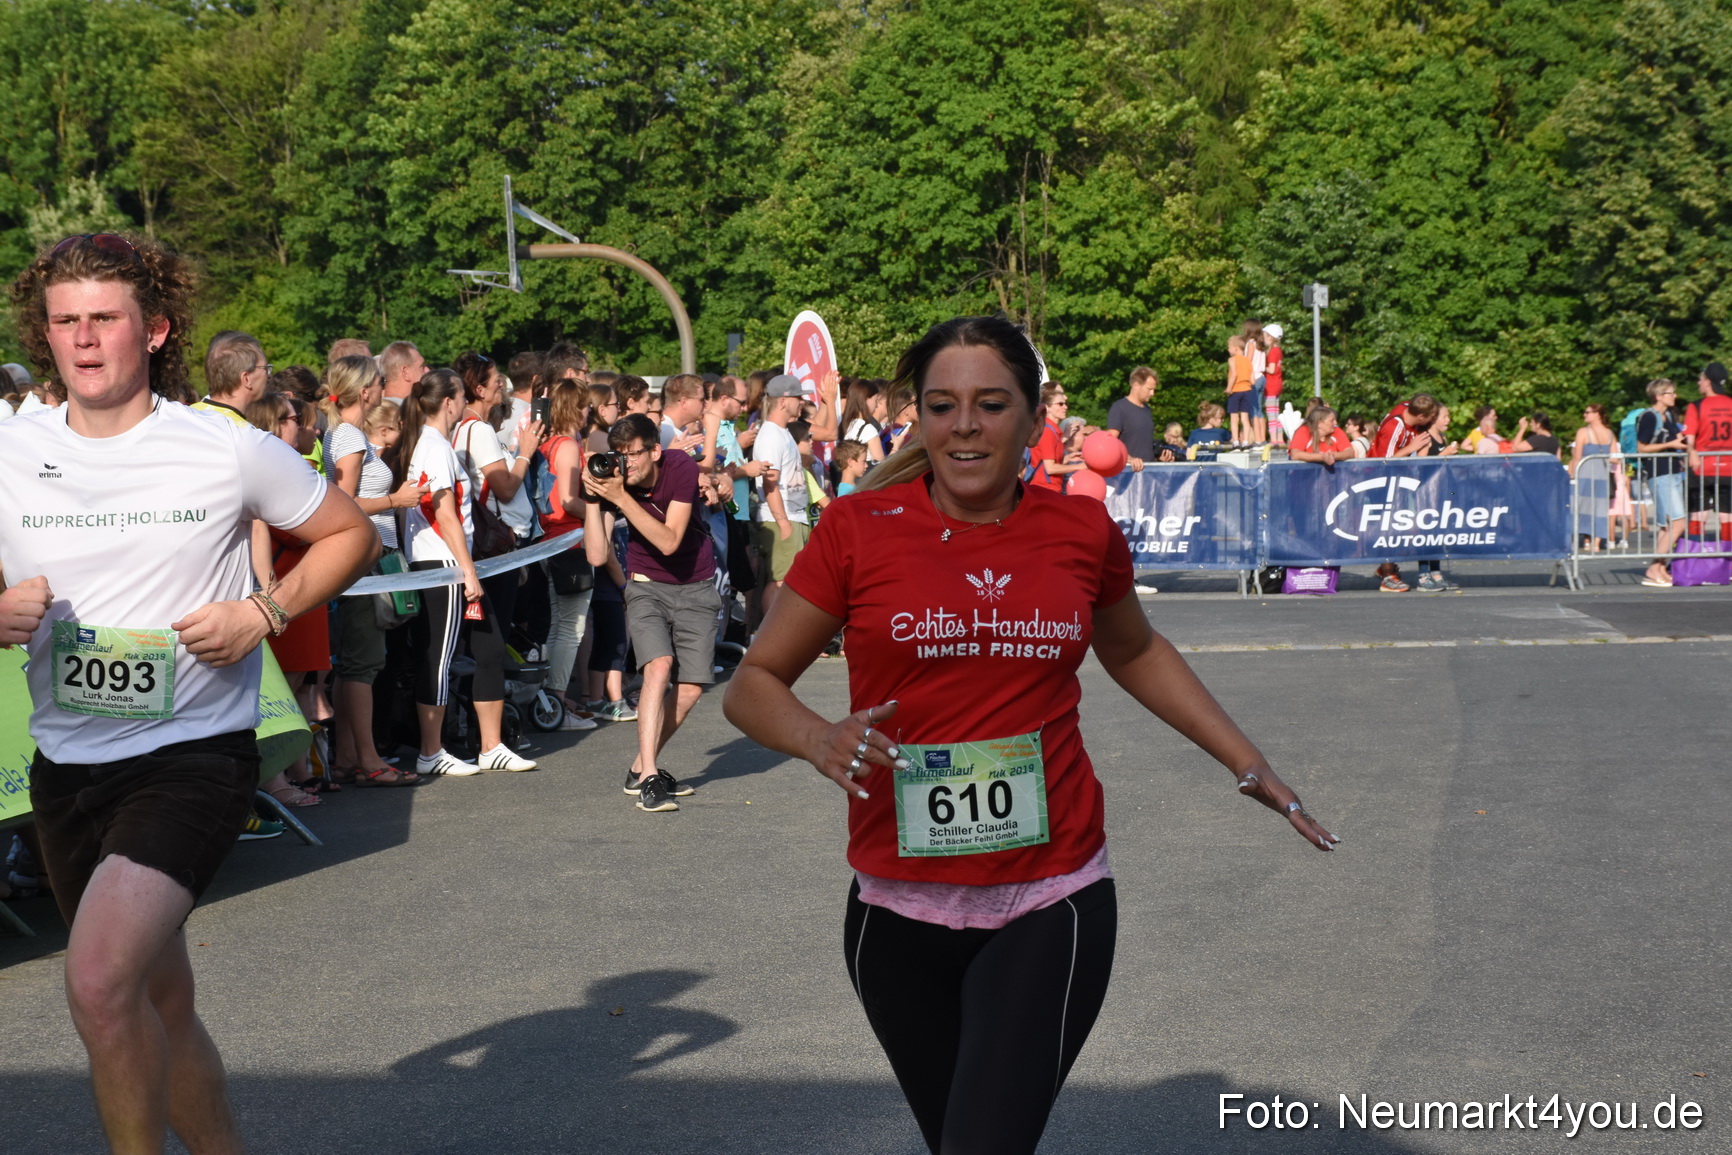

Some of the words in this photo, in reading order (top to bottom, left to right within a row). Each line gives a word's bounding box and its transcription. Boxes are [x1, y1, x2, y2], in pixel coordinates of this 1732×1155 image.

[22, 513, 117, 528] RUPPRECHT
[127, 509, 207, 525] HOLZBAU
[882, 506, 904, 516] JAKO
[1359, 500, 1509, 532] Fischer
[1114, 508, 1202, 537] cher
[1373, 532, 1496, 548] AUTOMOBILE
[890, 607, 969, 641] Echtes
[972, 608, 1083, 641] Handwerk
[917, 643, 980, 659] IMMER
[990, 643, 1061, 659] FRISCH
[64, 655, 156, 693] 2093
[70, 697, 100, 707] Rupprecht
[82, 690, 103, 700] Lurk
[105, 693, 134, 702] Jonas
[916, 764, 974, 778] firmenlauf
[1010, 764, 1035, 776] 2019
[927, 779, 1013, 825] 610
[929, 826, 973, 837] Schiller
[976, 820, 1018, 833] Claudia
[945, 837, 972, 845] Bäcker
[974, 835, 994, 843] Feihl
[995, 831, 1018, 840] GmbH
